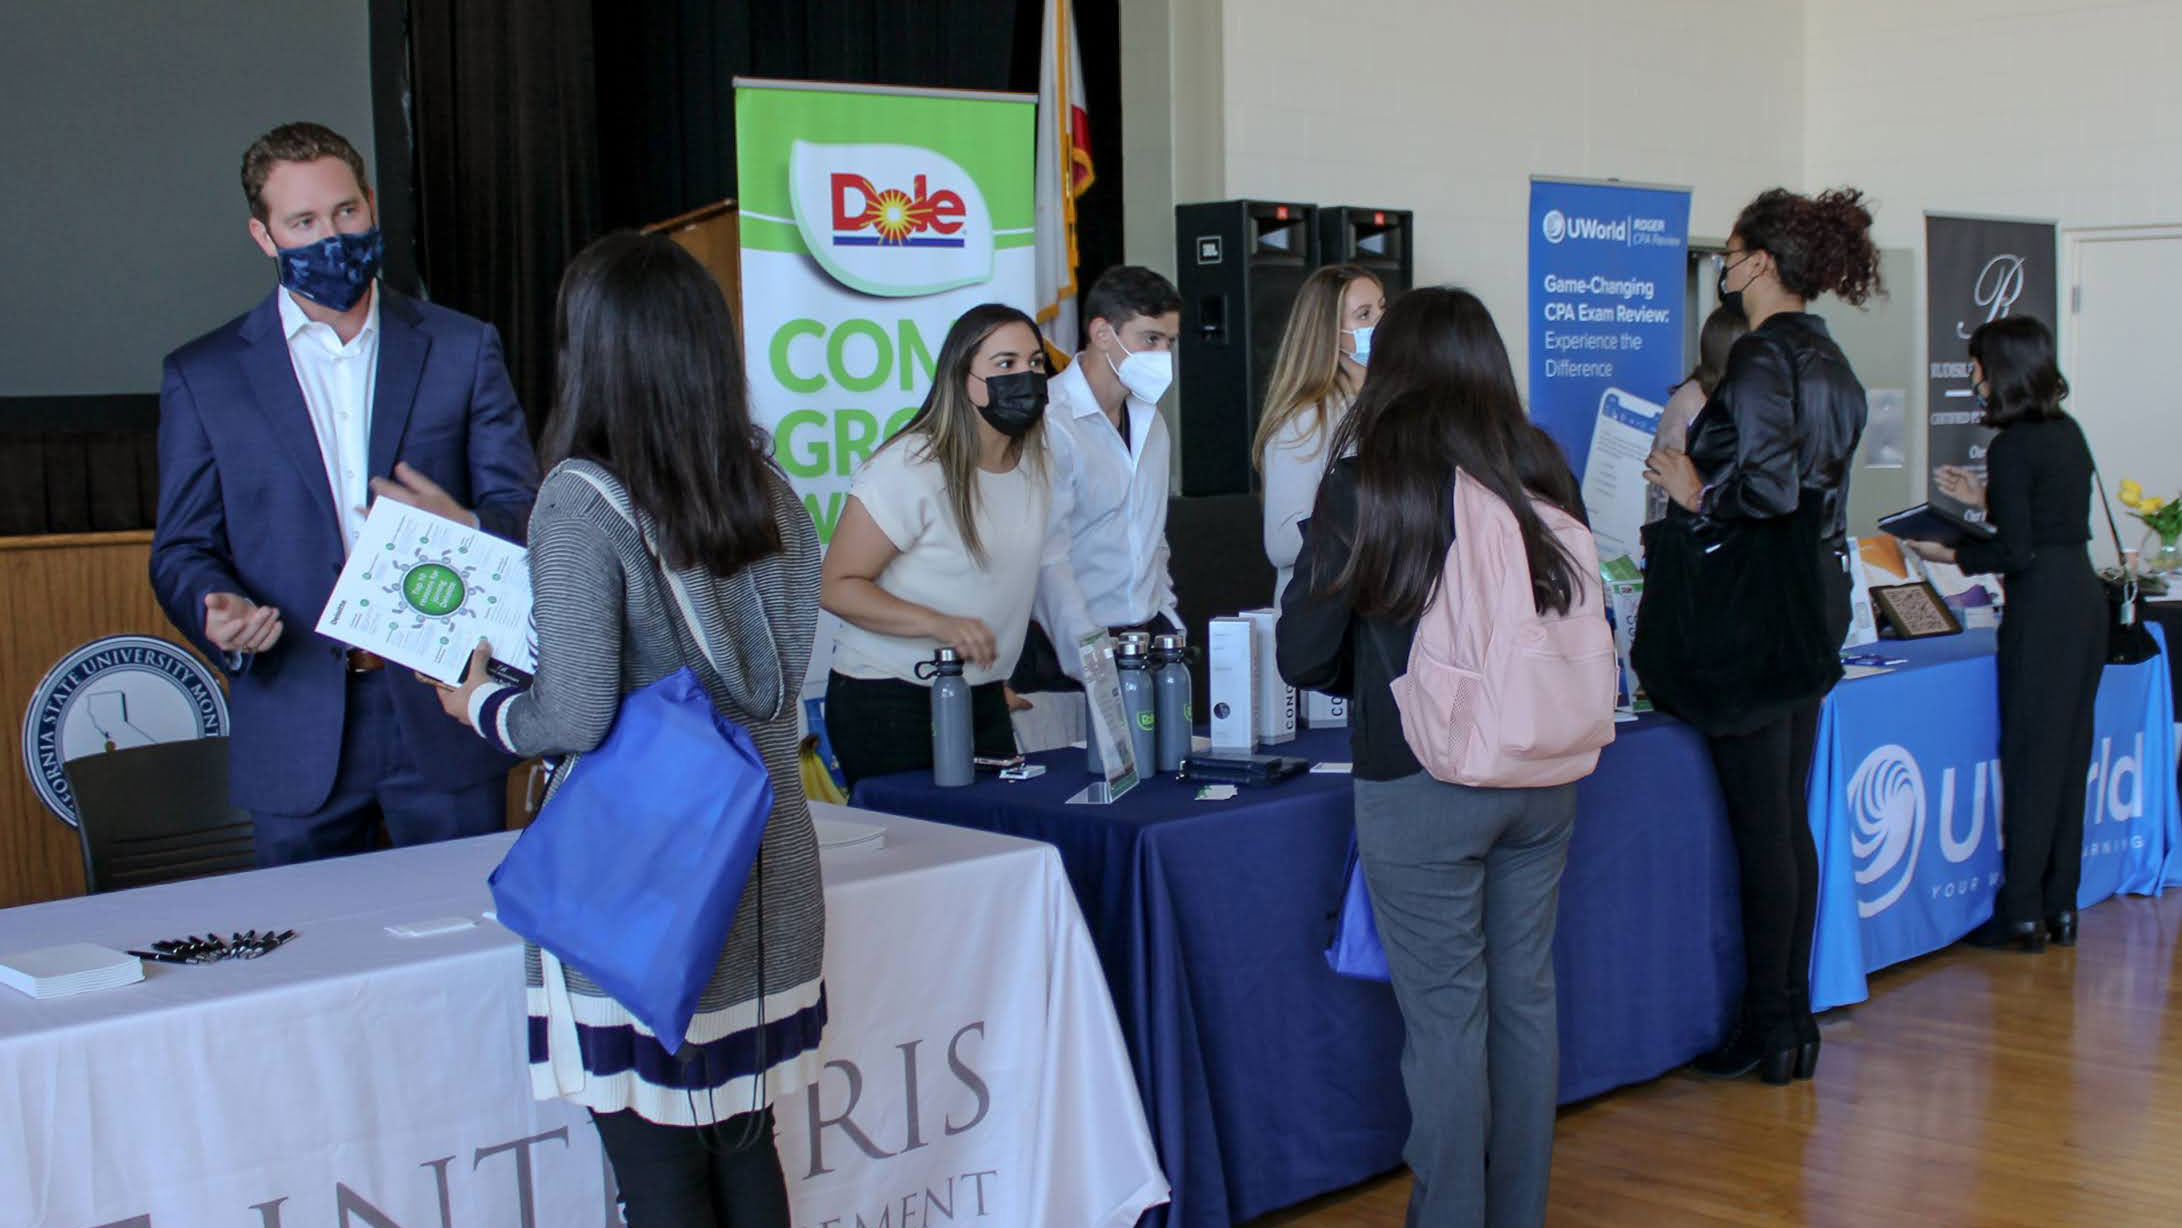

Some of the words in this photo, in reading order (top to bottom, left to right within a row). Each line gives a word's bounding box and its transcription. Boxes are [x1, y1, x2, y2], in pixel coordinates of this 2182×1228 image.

[831, 172, 966, 235] Dole
[1567, 217, 1626, 241] UWorld
[1544, 274, 1654, 300] Game-Changing
[1544, 302, 1575, 321] CPA
[1578, 304, 1614, 322] Exam
[1617, 304, 1670, 323] Review:
[1545, 330, 1618, 352] Experience
[1620, 332, 1643, 350] the
[1545, 358, 1613, 378] Difference
[43, 670, 83, 725] STATE
[83, 648, 195, 683] UNIVERSITY
[189, 683, 220, 737] MONT
